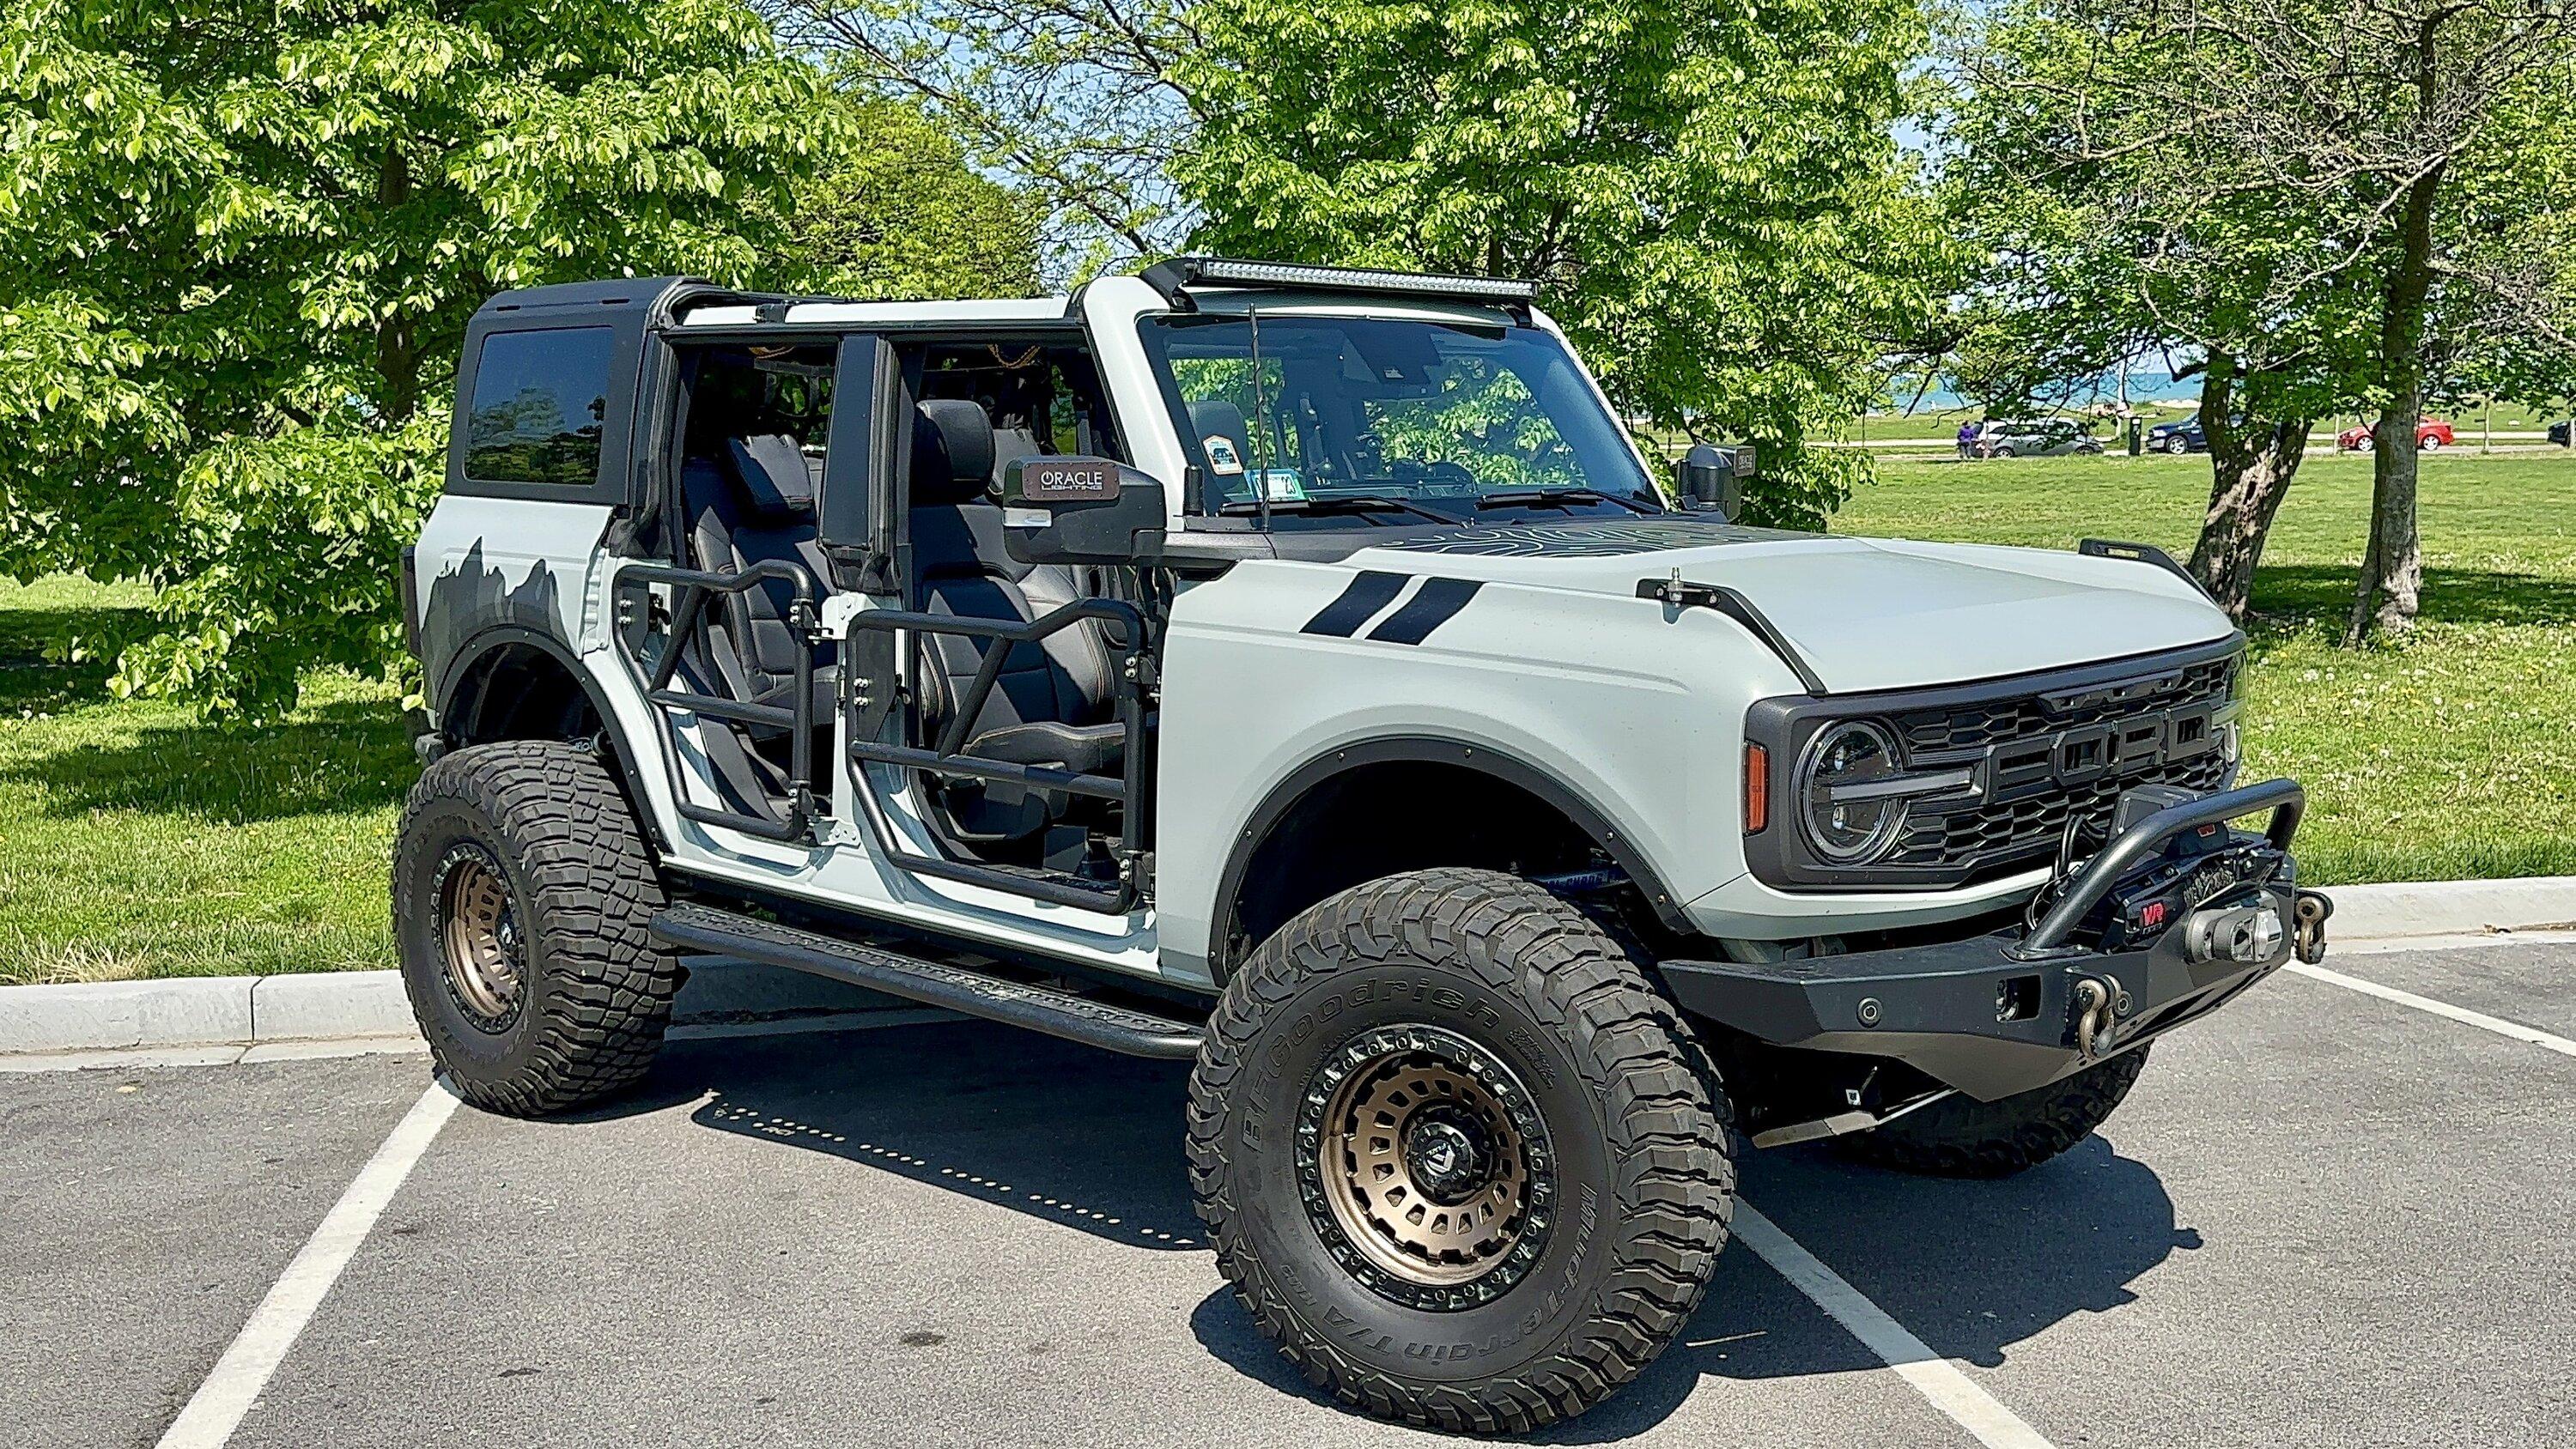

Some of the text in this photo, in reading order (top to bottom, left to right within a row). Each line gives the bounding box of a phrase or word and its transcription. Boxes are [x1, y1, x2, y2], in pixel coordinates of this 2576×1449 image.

[1041, 470, 1103, 485] ORACLE
[1985, 702, 2213, 805] FORD
[2142, 902, 2165, 925] VR
[1242, 977, 1501, 1153] BFGoodrich
[1405, 1182, 1598, 1367] Mud-Terrain
[1322, 1305, 1394, 1356] T/A
